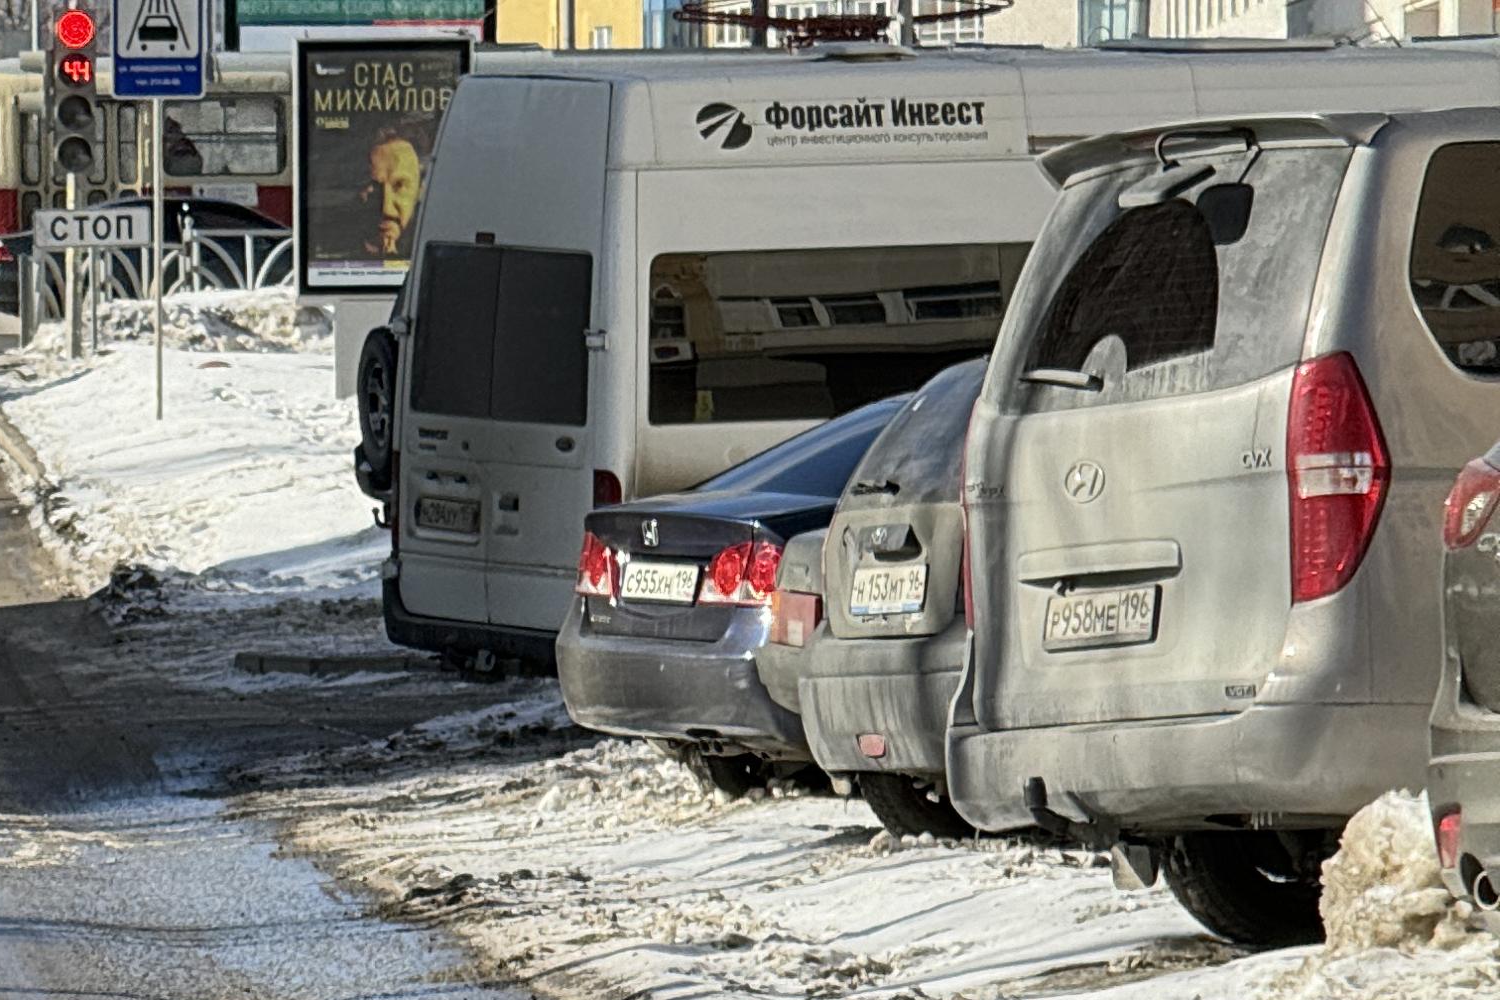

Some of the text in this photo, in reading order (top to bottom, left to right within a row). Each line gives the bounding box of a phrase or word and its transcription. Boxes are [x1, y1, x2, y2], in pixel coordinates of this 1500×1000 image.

[354, 62, 414, 87] СТАС
[314, 84, 453, 112] МИХАЙЛОВ
[764, 97, 985, 132] Форсайт Инвест
[767, 131, 988, 147] центр инвестиционного консультирования
[51, 214, 133, 241] СТОП
